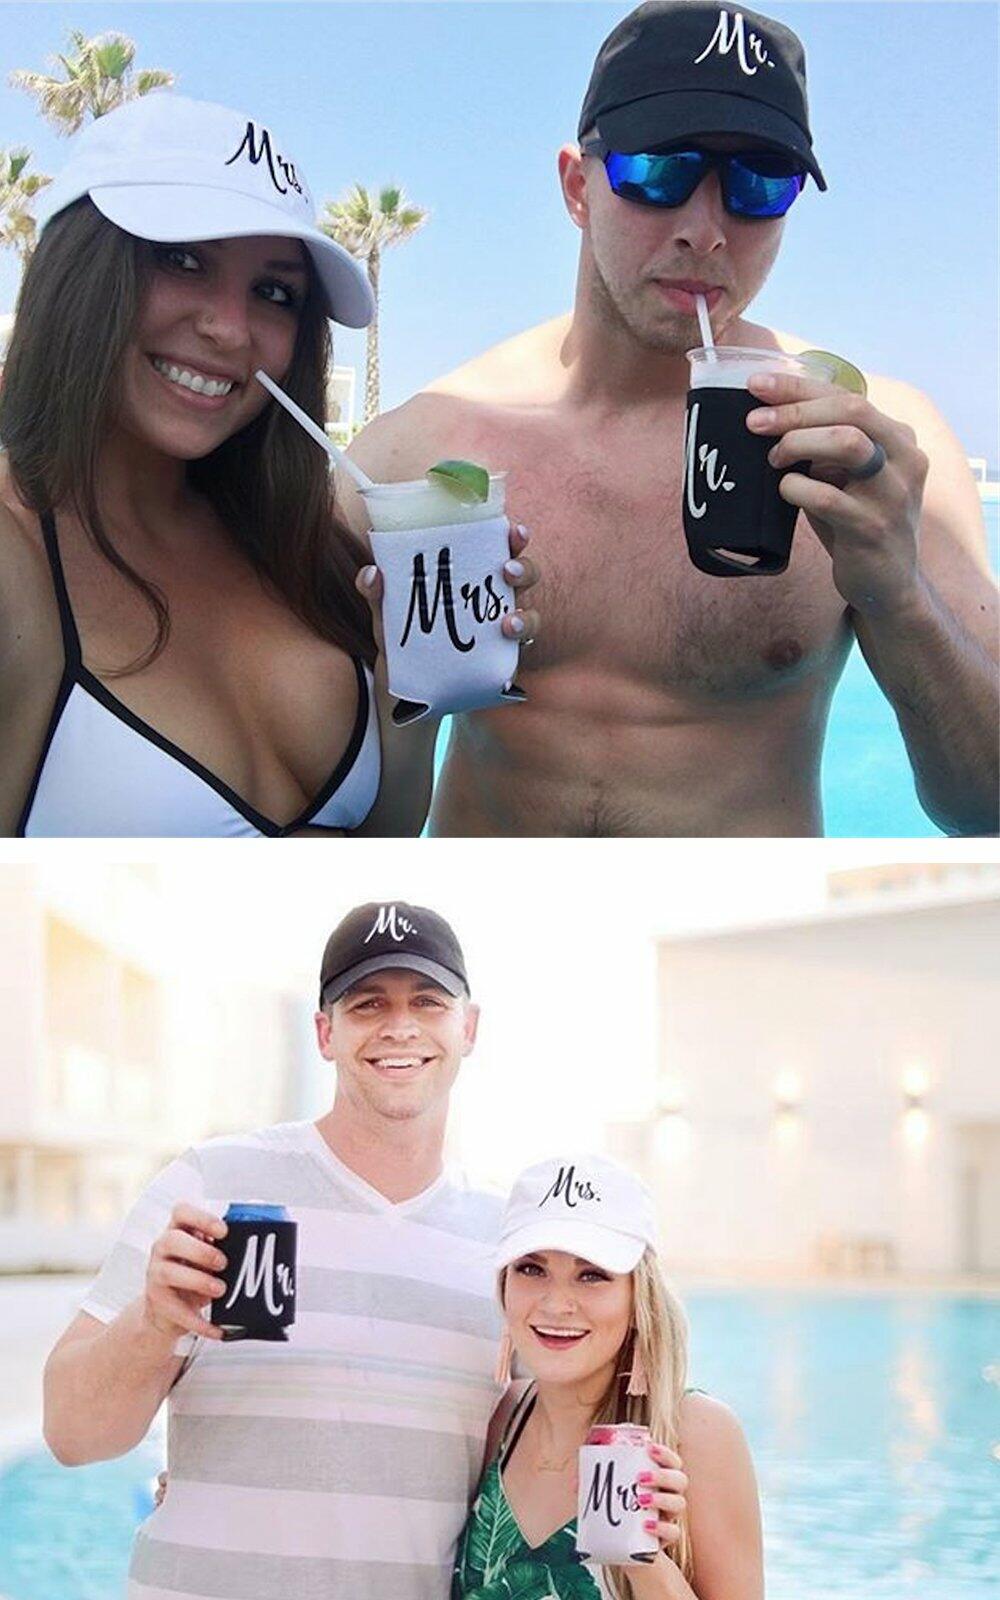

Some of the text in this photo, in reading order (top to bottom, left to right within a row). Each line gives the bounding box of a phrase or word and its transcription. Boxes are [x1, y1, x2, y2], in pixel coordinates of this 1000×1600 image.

[694, 9, 776, 76] Mr.
[400, 547, 509, 652] Mrs.
[363, 904, 418, 944] Mr.
[538, 1165, 601, 1207] Mrs.
[225, 1232, 294, 1316] Mr.
